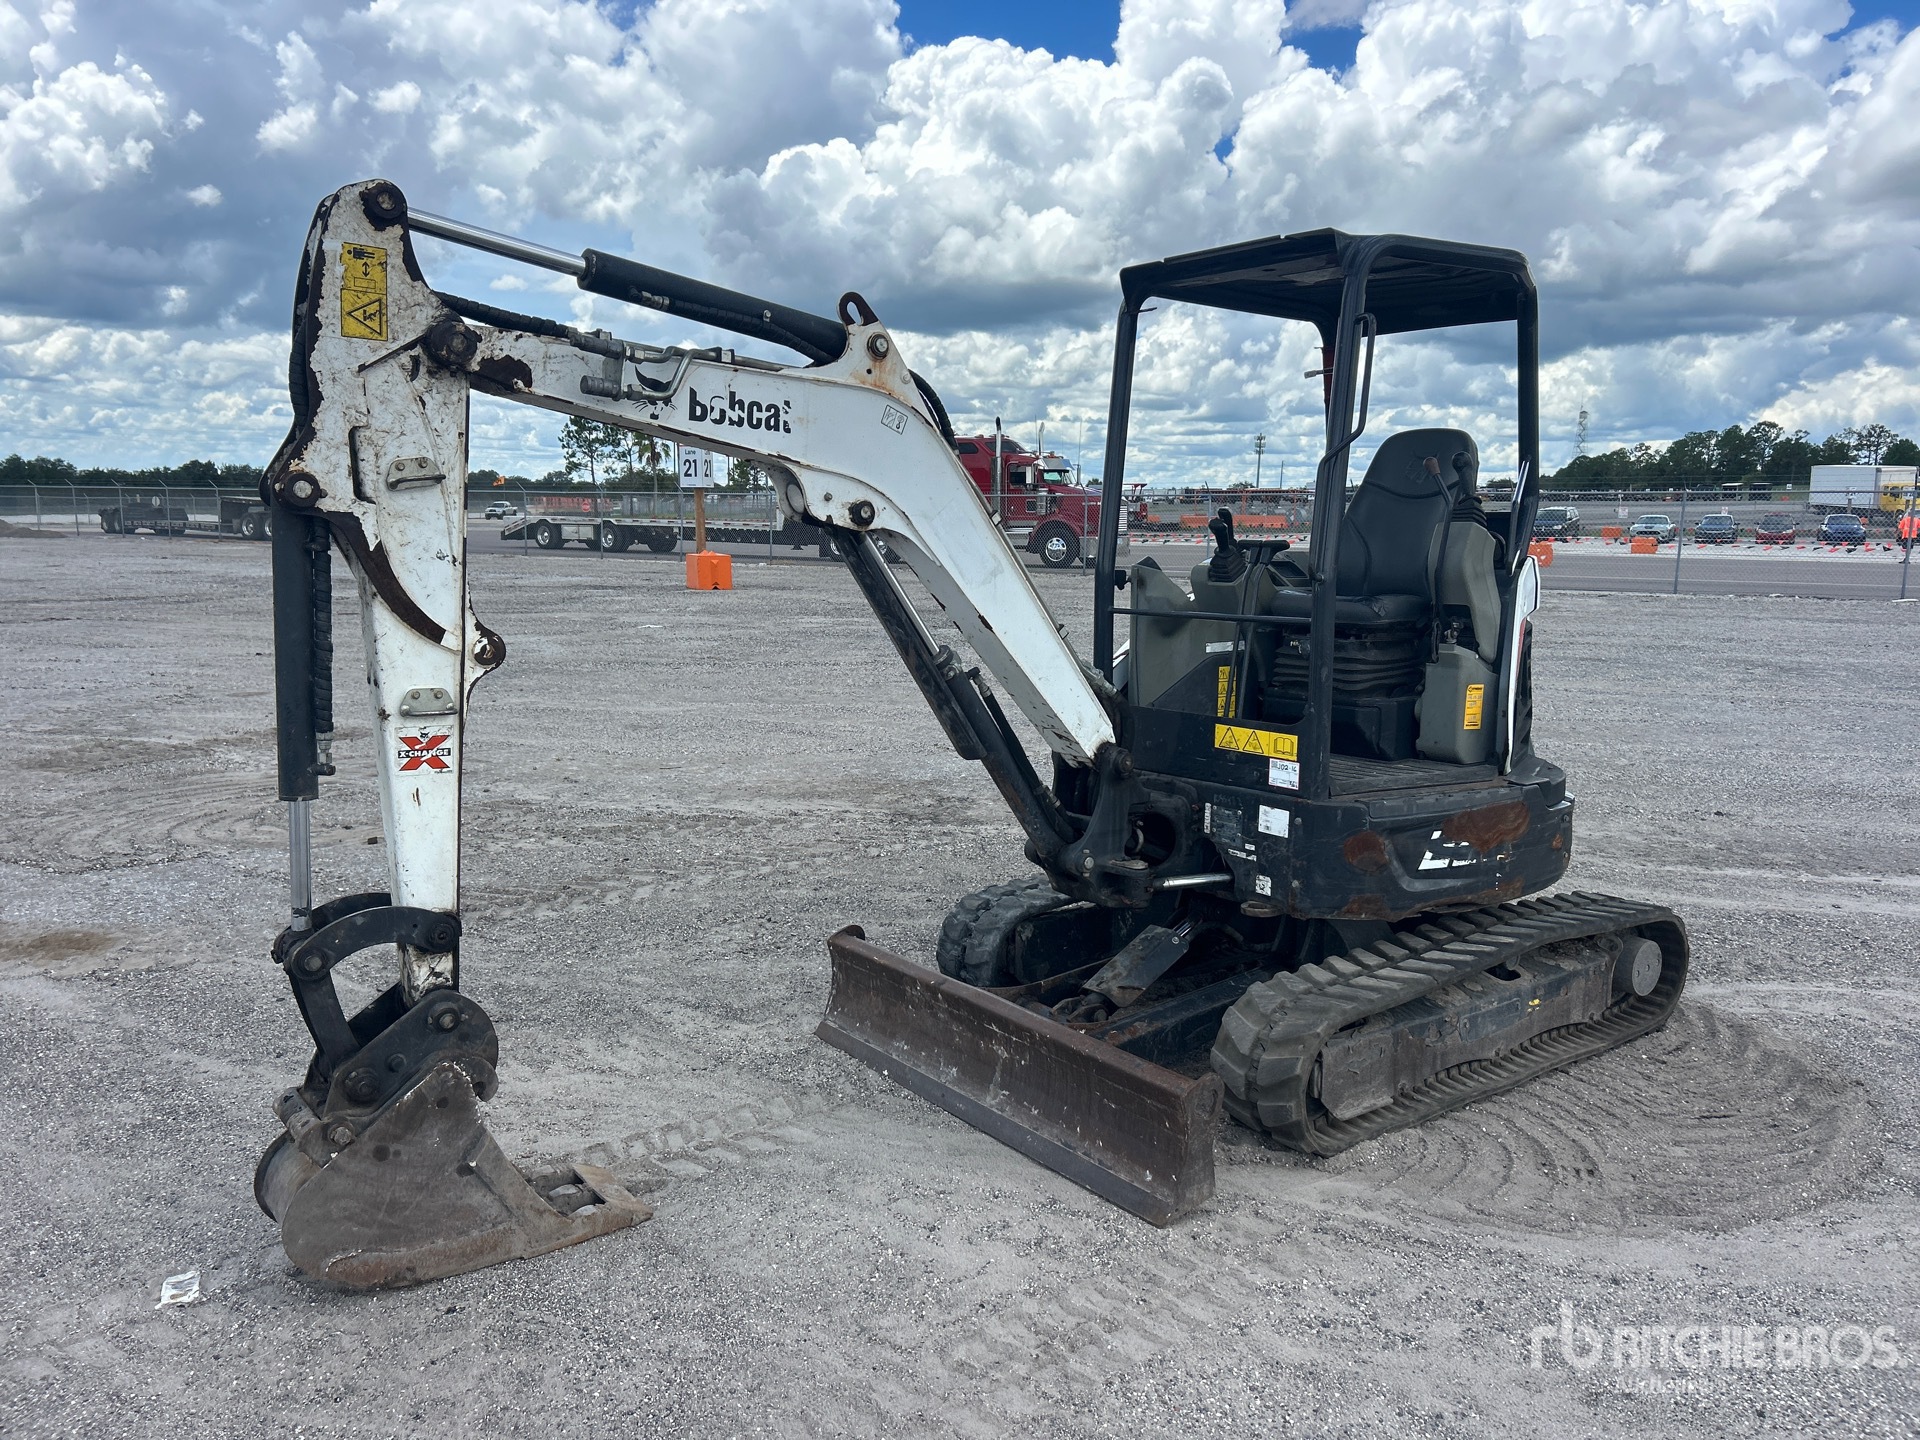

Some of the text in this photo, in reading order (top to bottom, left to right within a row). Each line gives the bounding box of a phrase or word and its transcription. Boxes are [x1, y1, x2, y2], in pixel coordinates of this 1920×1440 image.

[684, 448, 697, 456] Lane
[683, 458, 698, 478] 21
[703, 458, 712, 478] 21
[398, 748, 450, 758] X-CHANGE
